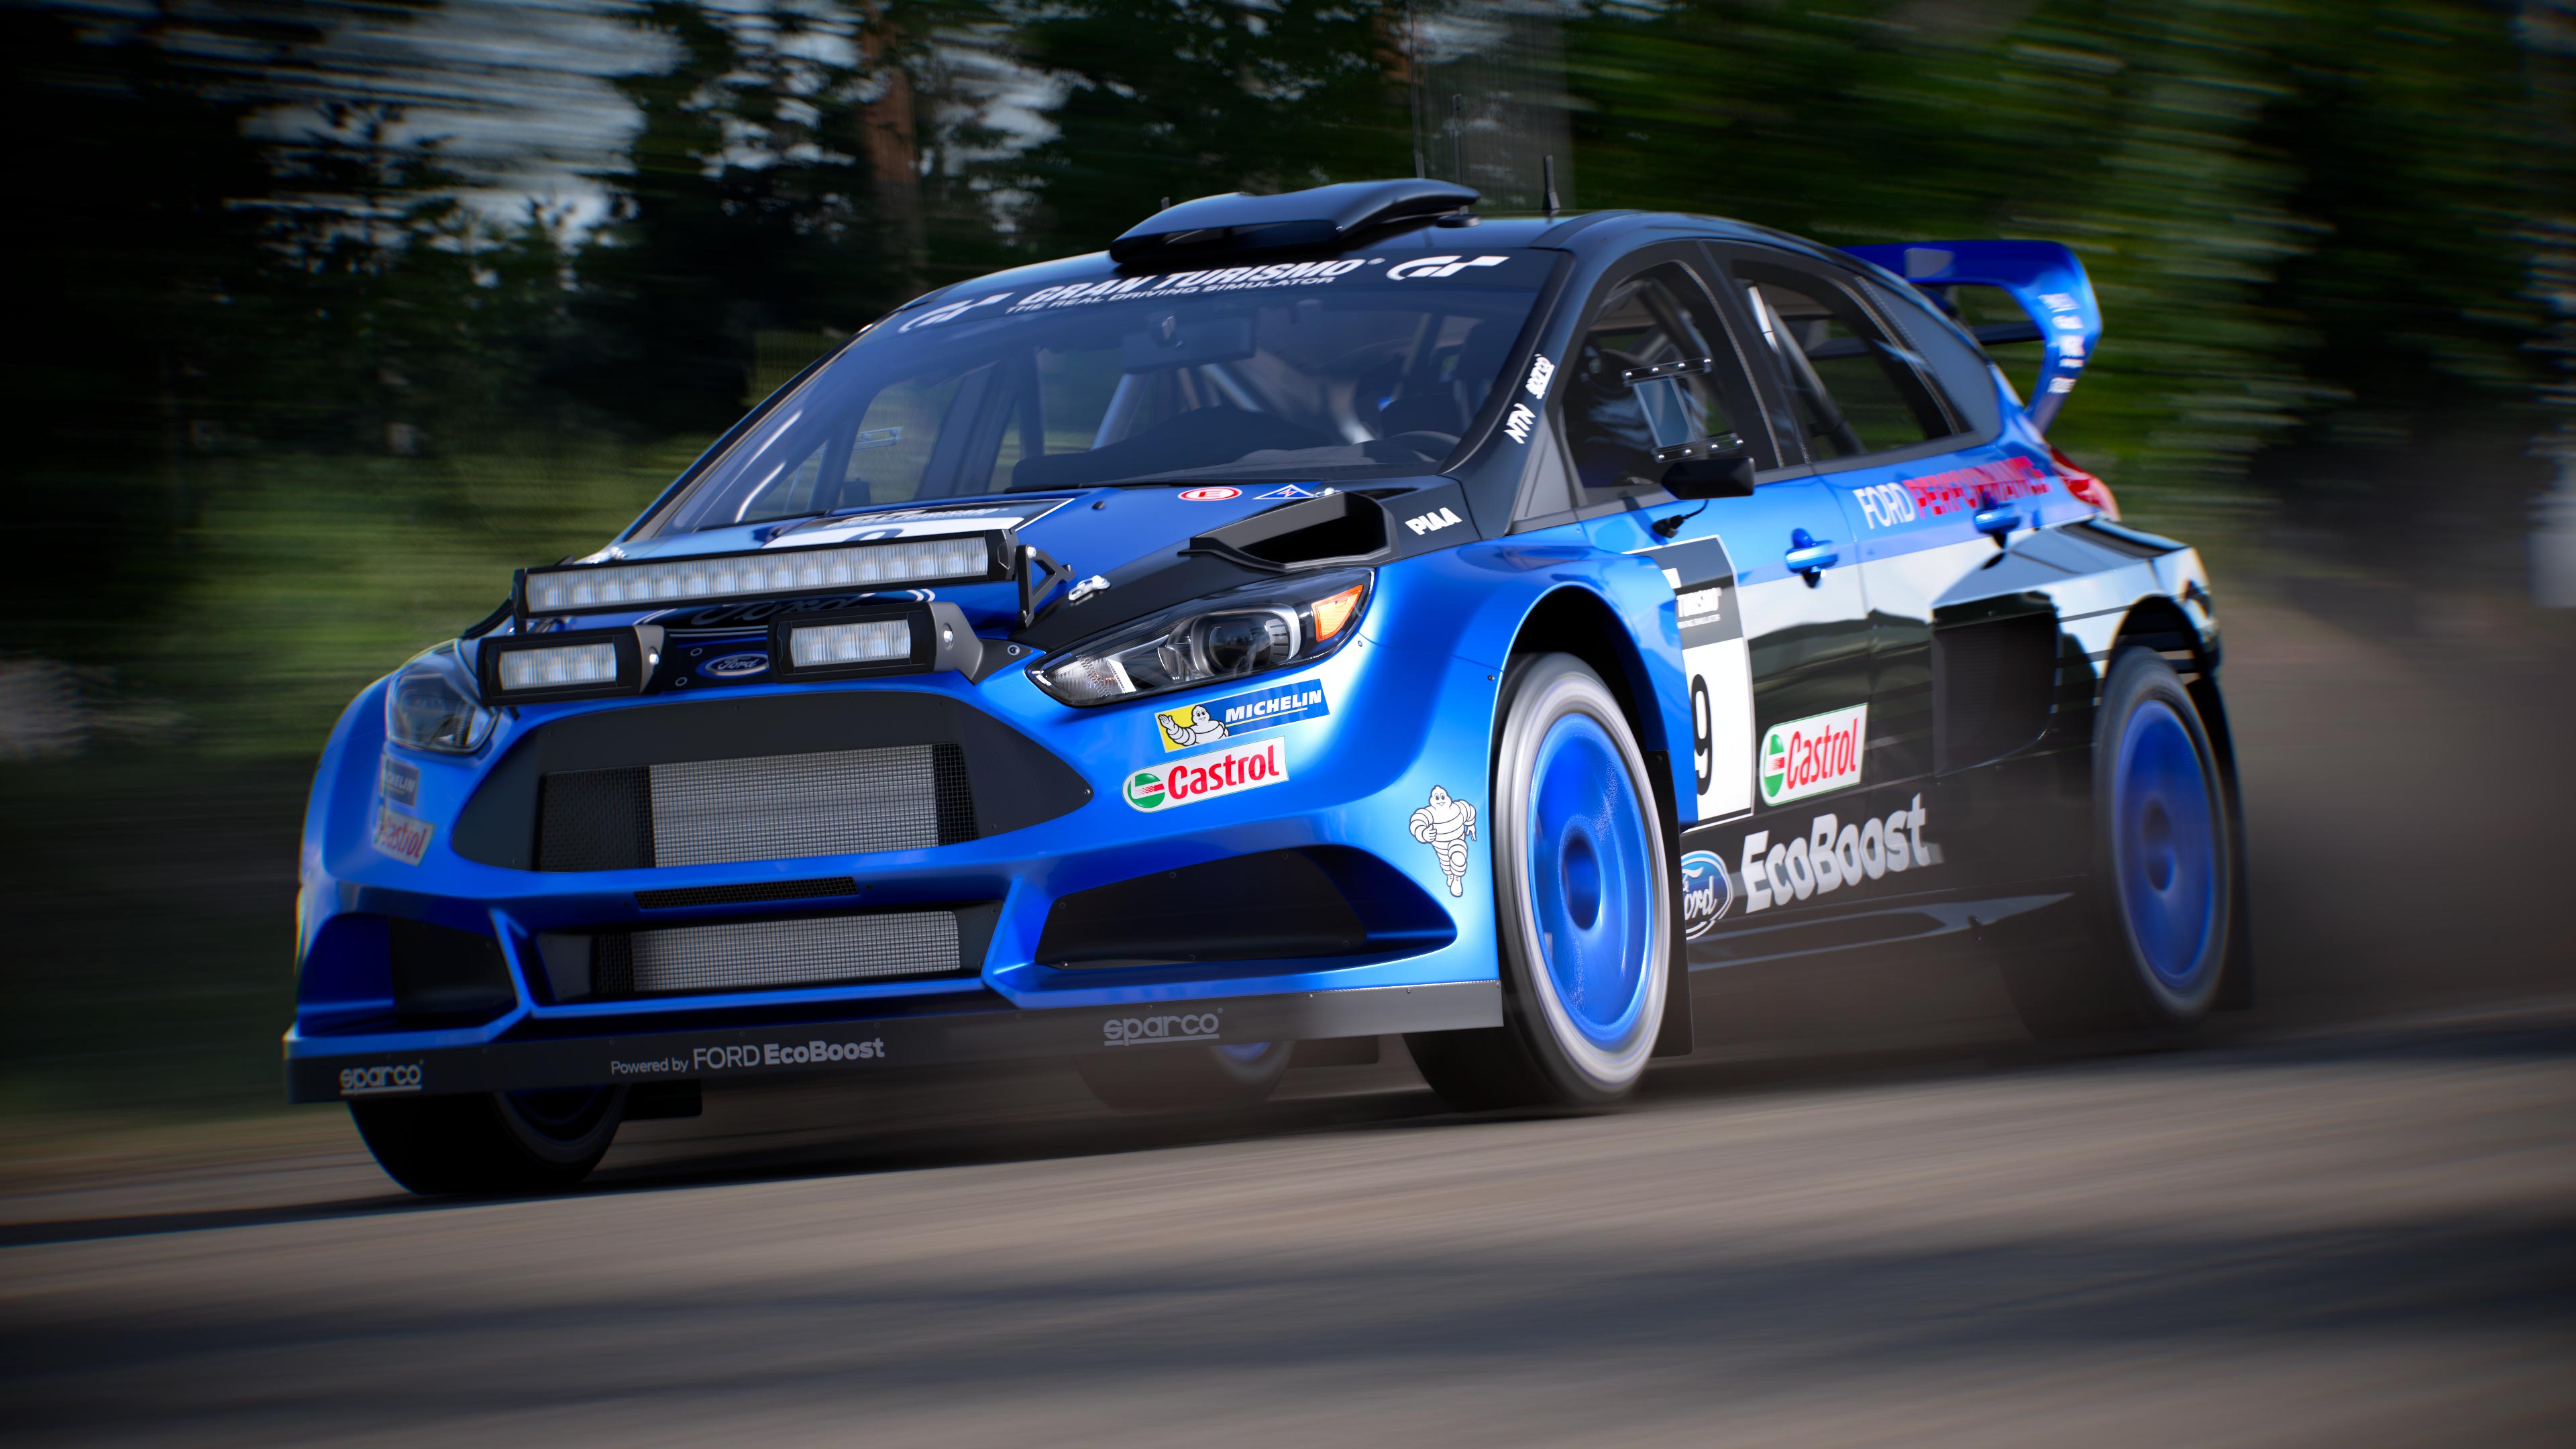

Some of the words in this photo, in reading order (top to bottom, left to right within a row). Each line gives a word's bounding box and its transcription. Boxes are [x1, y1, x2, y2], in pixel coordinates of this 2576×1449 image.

[1005, 302, 1044, 315] THE
[1048, 297, 1104, 309] REAL
[1107, 286, 1199, 302] DRIVING
[1201, 276, 1336, 292] SIMULATOR
[1016, 275, 1159, 306] GRAN
[1503, 402, 1536, 444] NTN
[1405, 507, 1462, 535] PIAA
[1852, 482, 1915, 529] FORD
[718, 657, 759, 670] Ford
[1225, 690, 1322, 723] MICHELIN
[1690, 674, 1713, 796] 9
[1786, 717, 1858, 790] Castrol
[1168, 745, 1279, 800] Castrol
[1741, 792, 1931, 913] EcoBoost
[611, 1058, 669, 1075] Powered
[672, 1058, 688, 1073] by
[694, 1044, 760, 1069] FORD
[763, 1037, 885, 1065] EcoBoost
